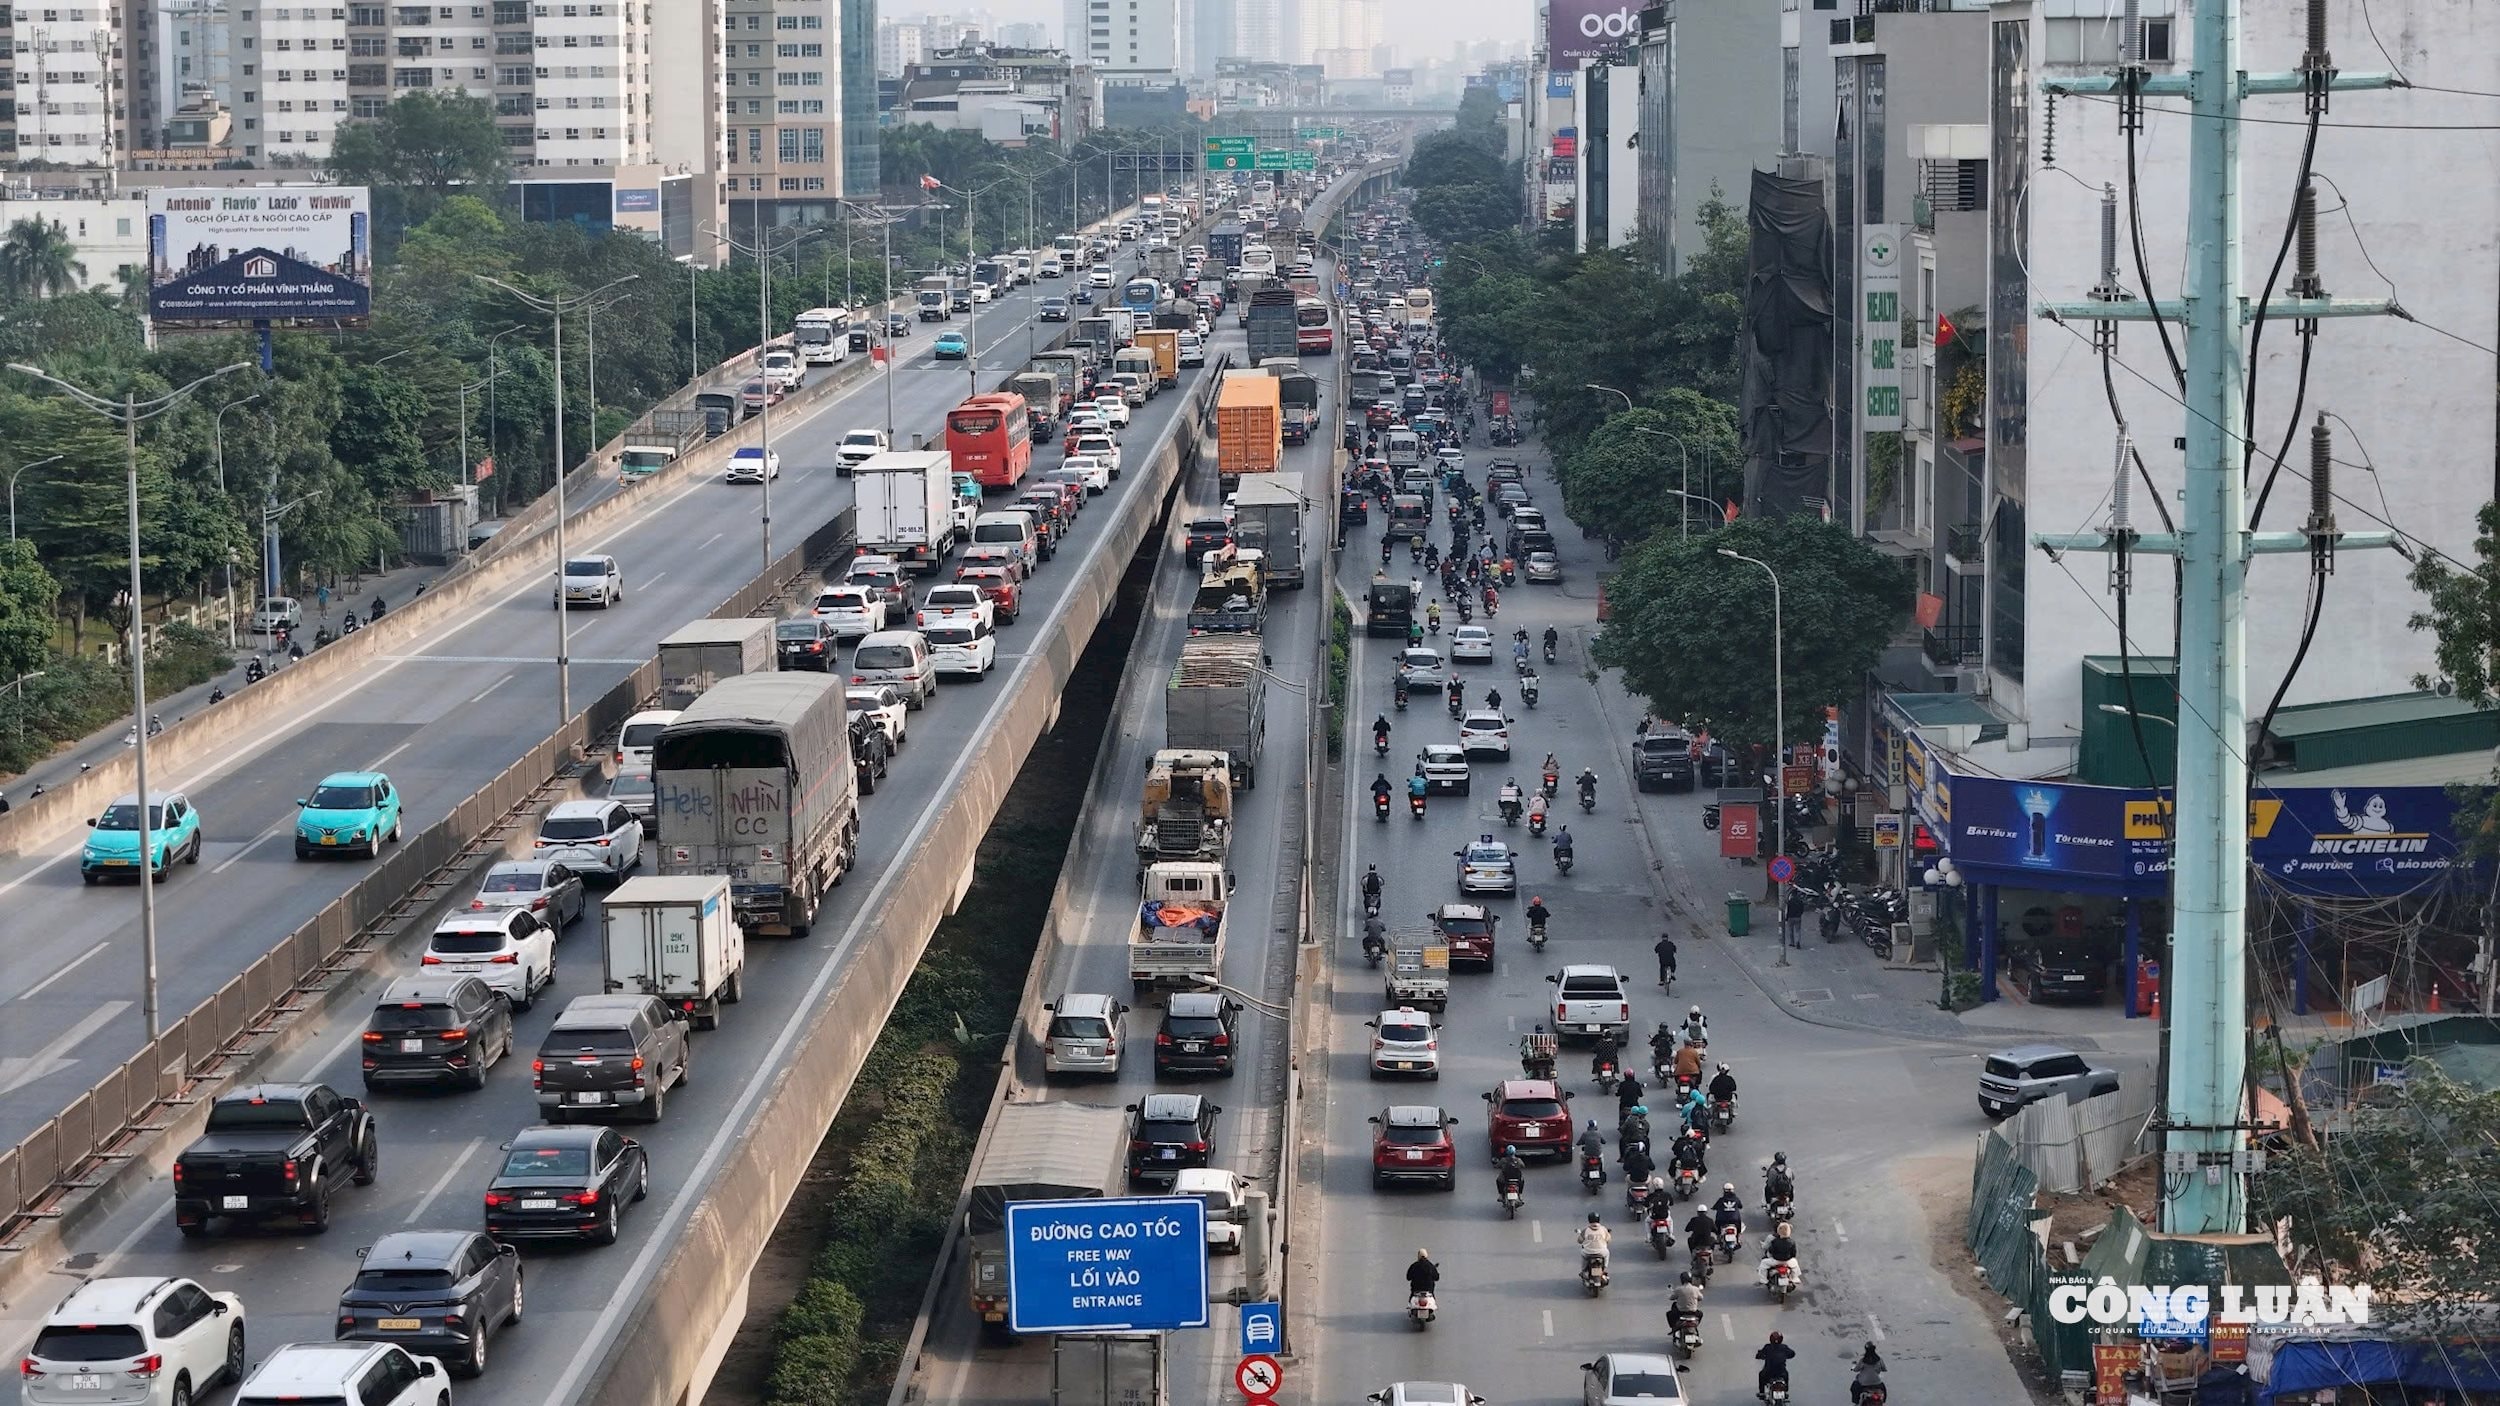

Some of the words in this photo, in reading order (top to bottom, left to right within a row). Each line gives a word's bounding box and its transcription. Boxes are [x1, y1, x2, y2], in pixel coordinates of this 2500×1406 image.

[186, 215, 213, 223] GẠCH
[232, 214, 250, 222] LÁT
[289, 214, 310, 222] CAO
[187, 284, 215, 295] CÔNG
[217, 286, 230, 295] TY
[1867, 292, 1898, 322] HEALTH
[1872, 339, 1894, 369] CARE
[1867, 386, 1900, 416] CENTER
[1731, 825, 1748, 835] 5G
[2055, 834, 2071, 844] TÔI
[2098, 837, 2114, 847] SÓC
[2310, 839, 2428, 854] MICHELIN
[2301, 863, 2322, 872] PHỤ
[2397, 859, 2420, 868] BẢO
[670, 933, 684, 942] 29C
[666, 945, 689, 953] 112.71
[1031, 1221, 1093, 1241] ĐƯỜNG
[1099, 1222, 1137, 1239] CAO
[1142, 1216, 1181, 1237] TỐC
[1068, 1250, 1100, 1262] FREE
[1105, 1249, 1131, 1261] WAY
[1071, 1267, 1100, 1287] LỐI
[1106, 1267, 1140, 1285] VÀO
[1073, 1295, 1142, 1308] ENTRANCE
